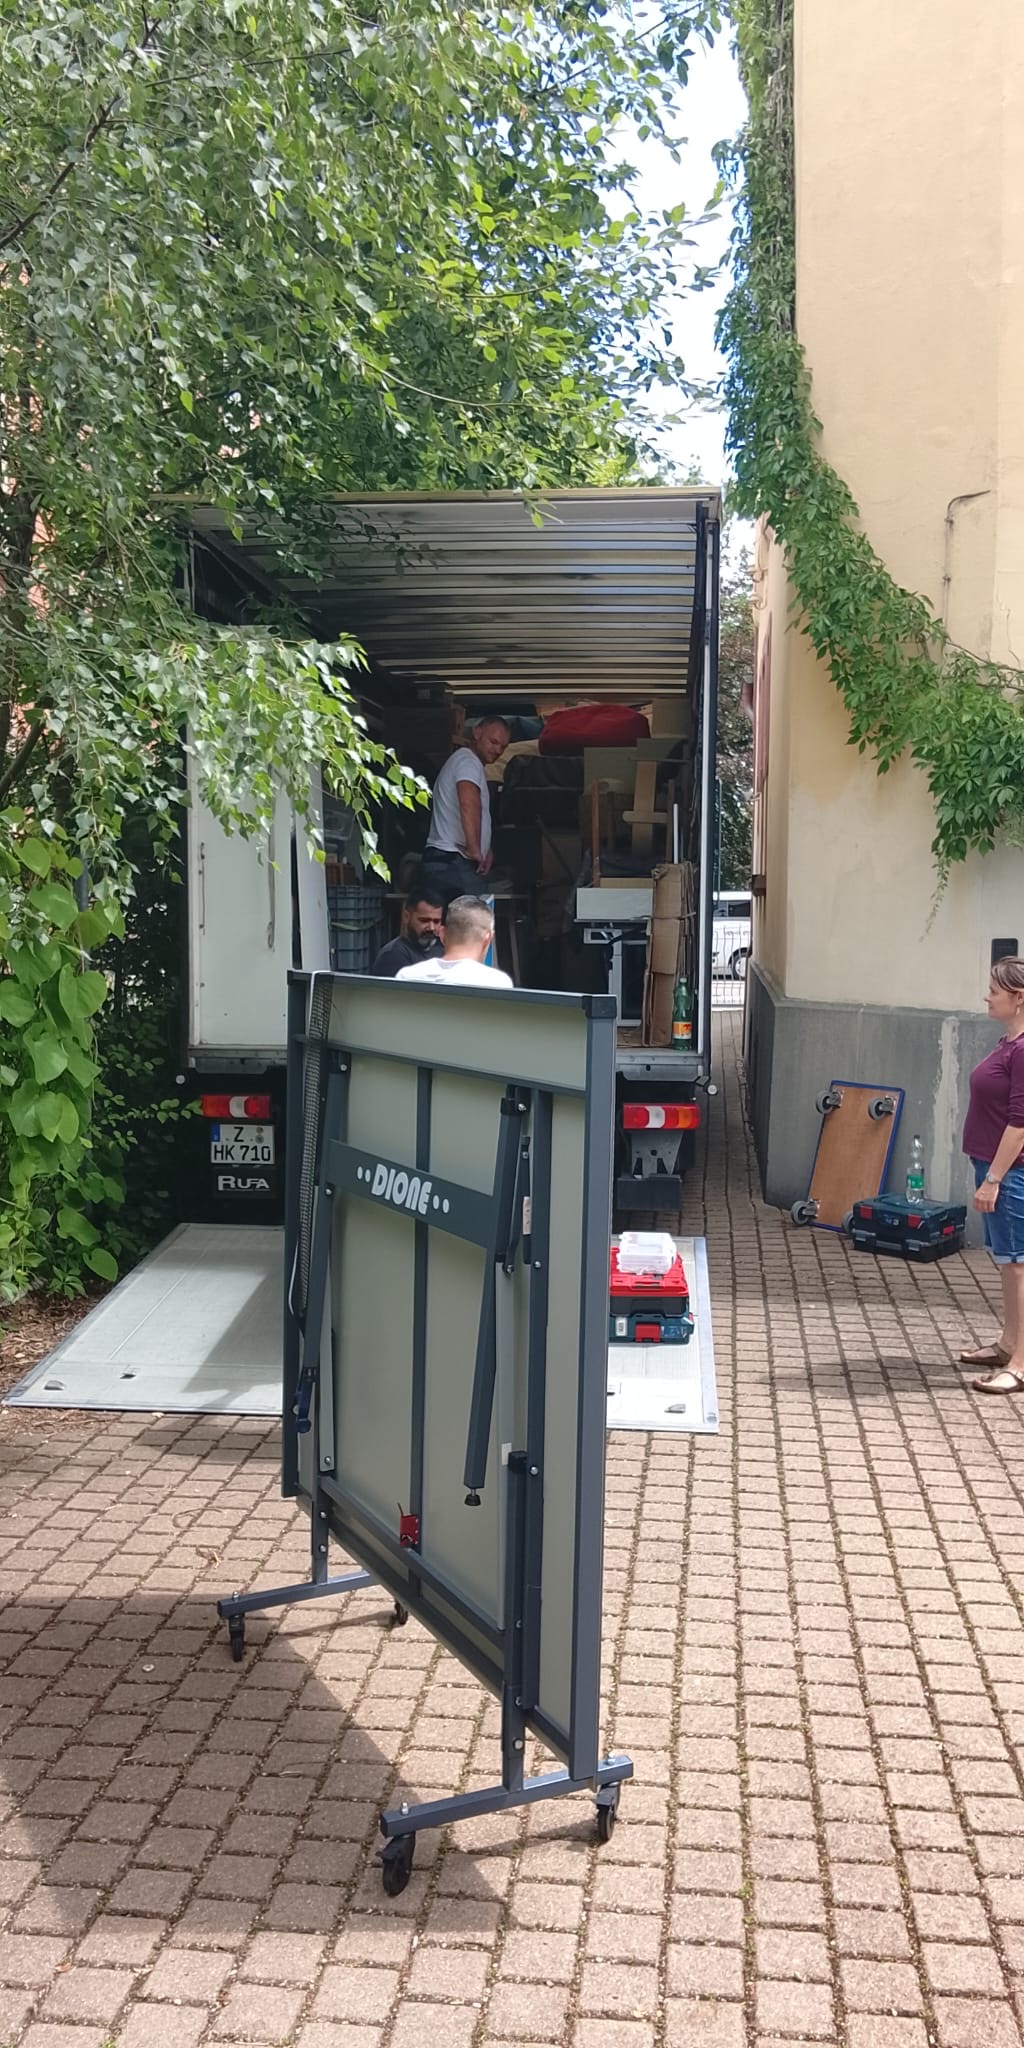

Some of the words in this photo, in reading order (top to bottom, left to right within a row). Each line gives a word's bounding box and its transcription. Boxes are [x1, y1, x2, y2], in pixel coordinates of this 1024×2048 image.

[233, 1126, 244, 1143] Z
[213, 1144, 235, 1161] HK
[240, 1145, 271, 1162] 710
[217, 1175, 270, 1191] RUFA
[371, 1163, 433, 1215] DIONE
